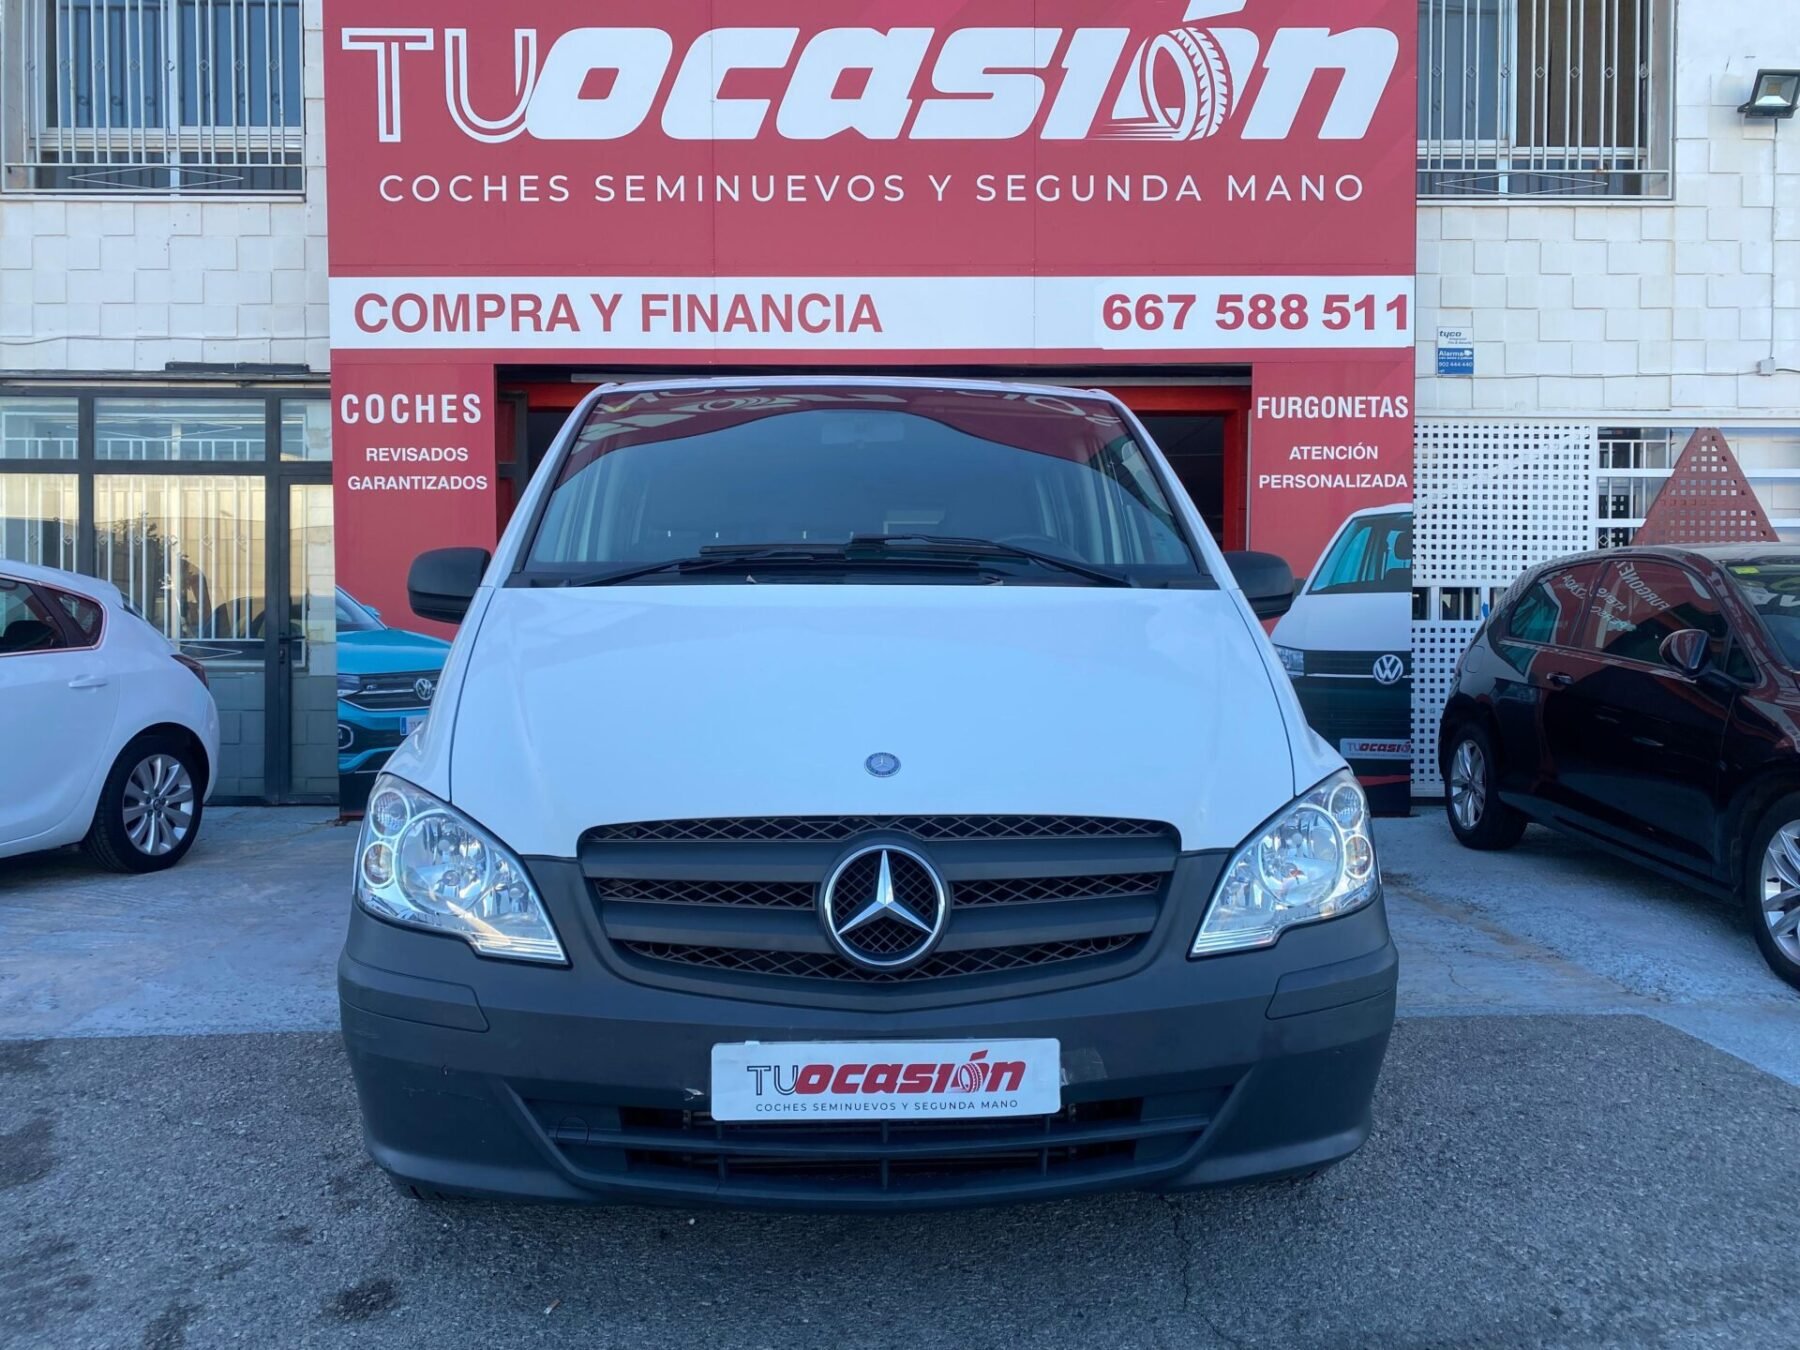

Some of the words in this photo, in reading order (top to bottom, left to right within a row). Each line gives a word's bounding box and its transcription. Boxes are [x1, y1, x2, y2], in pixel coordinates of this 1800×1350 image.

[379, 174, 569, 202] COCHES
[595, 174, 905, 202] SEMINUEVOS
[928, 174, 952, 201] Y
[976, 174, 1202, 202] SEGUNDA
[1228, 174, 1364, 202] MANO
[354, 293, 581, 334] COMPRA
[591, 294, 623, 332] Y
[641, 293, 883, 333] FINANCIA
[1102, 293, 1197, 331] 667
[1215, 293, 1309, 331] 588
[1321, 293, 1407, 331] 511
[1439, 330, 1462, 338] tyco
[341, 393, 481, 424] COCHES
[1257, 395, 1409, 419] FURGONETAS
[366, 447, 469, 462] REVISADOS
[1289, 442, 1378, 460] ATENCIÓN
[347, 475, 488, 491] GARANTIZADOS
[1259, 473, 1408, 489] PERSONALIZADA
[755, 1102, 807, 1112] COCHES
[812, 1101, 897, 1112] SEMINUEVOS
[901, 1101, 909, 1111] Y
[914, 1100, 976, 1111] SEGUNDA
[980, 1099, 1018, 1110] MANO
